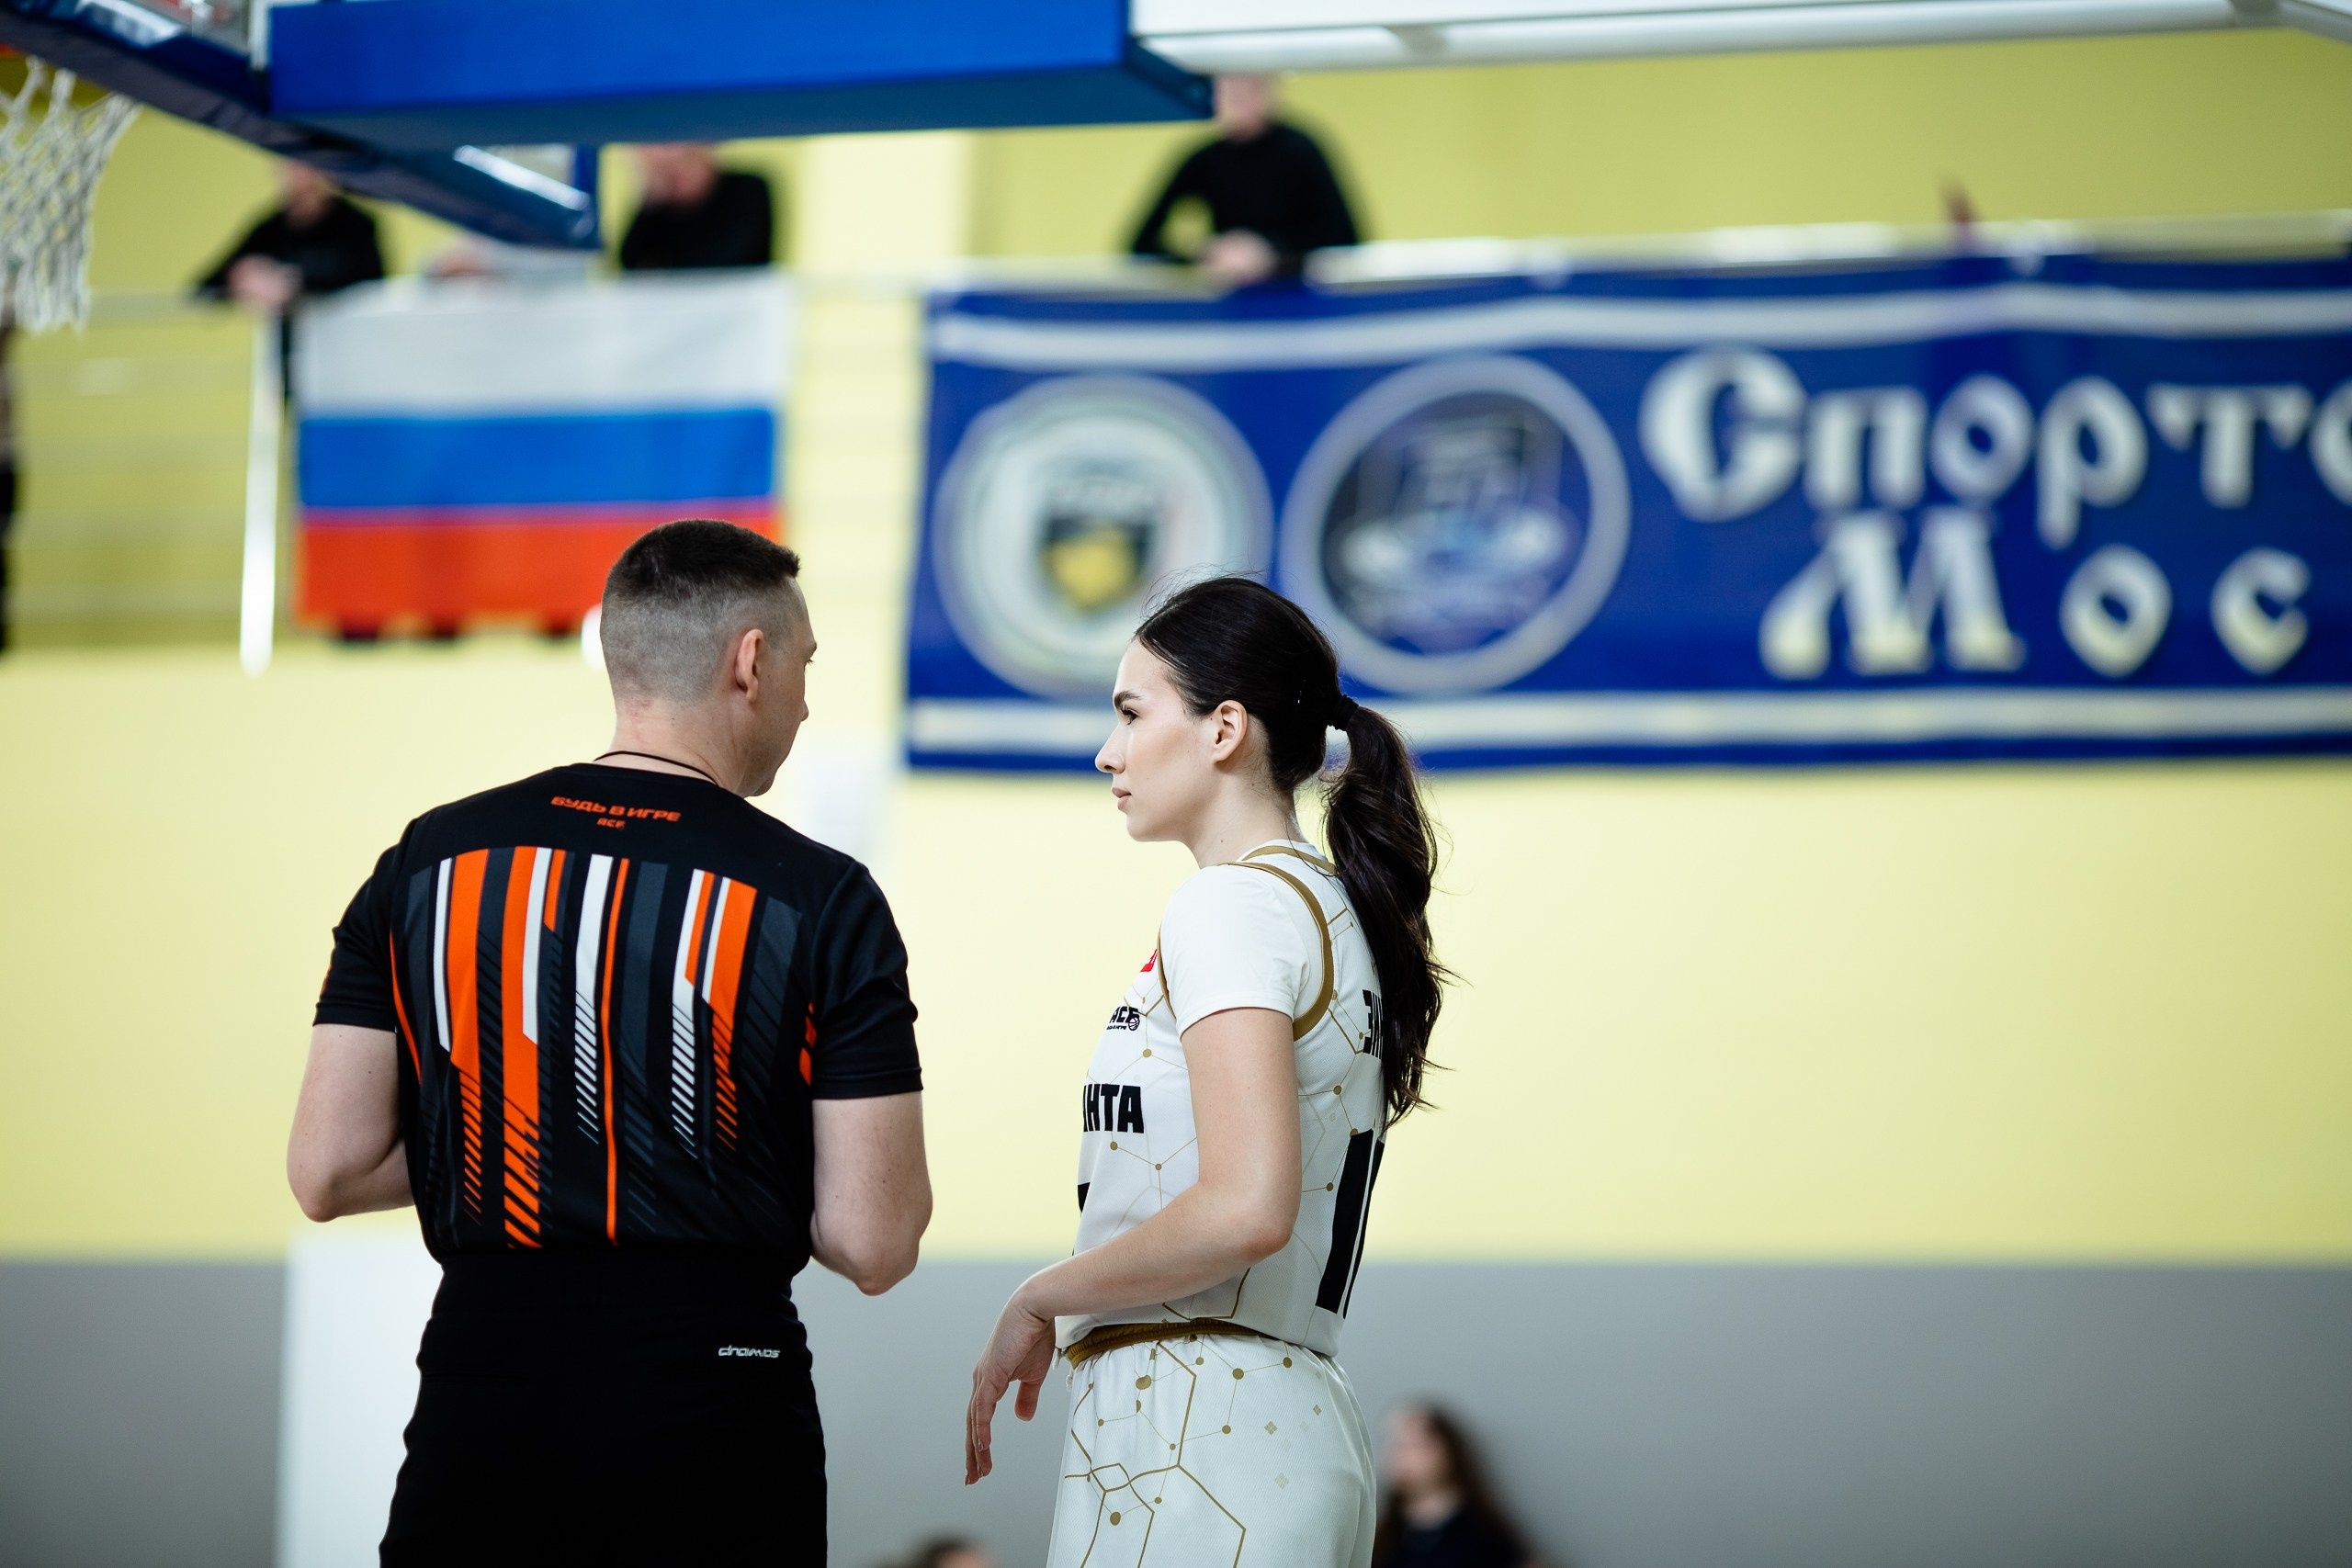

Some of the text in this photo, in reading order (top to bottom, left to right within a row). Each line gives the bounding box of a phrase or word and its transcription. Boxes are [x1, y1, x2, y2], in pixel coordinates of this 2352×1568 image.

[550, 795, 682, 822] БУДЬ В ИГРЕ
[1082, 1083, 1145, 1134] НТА
